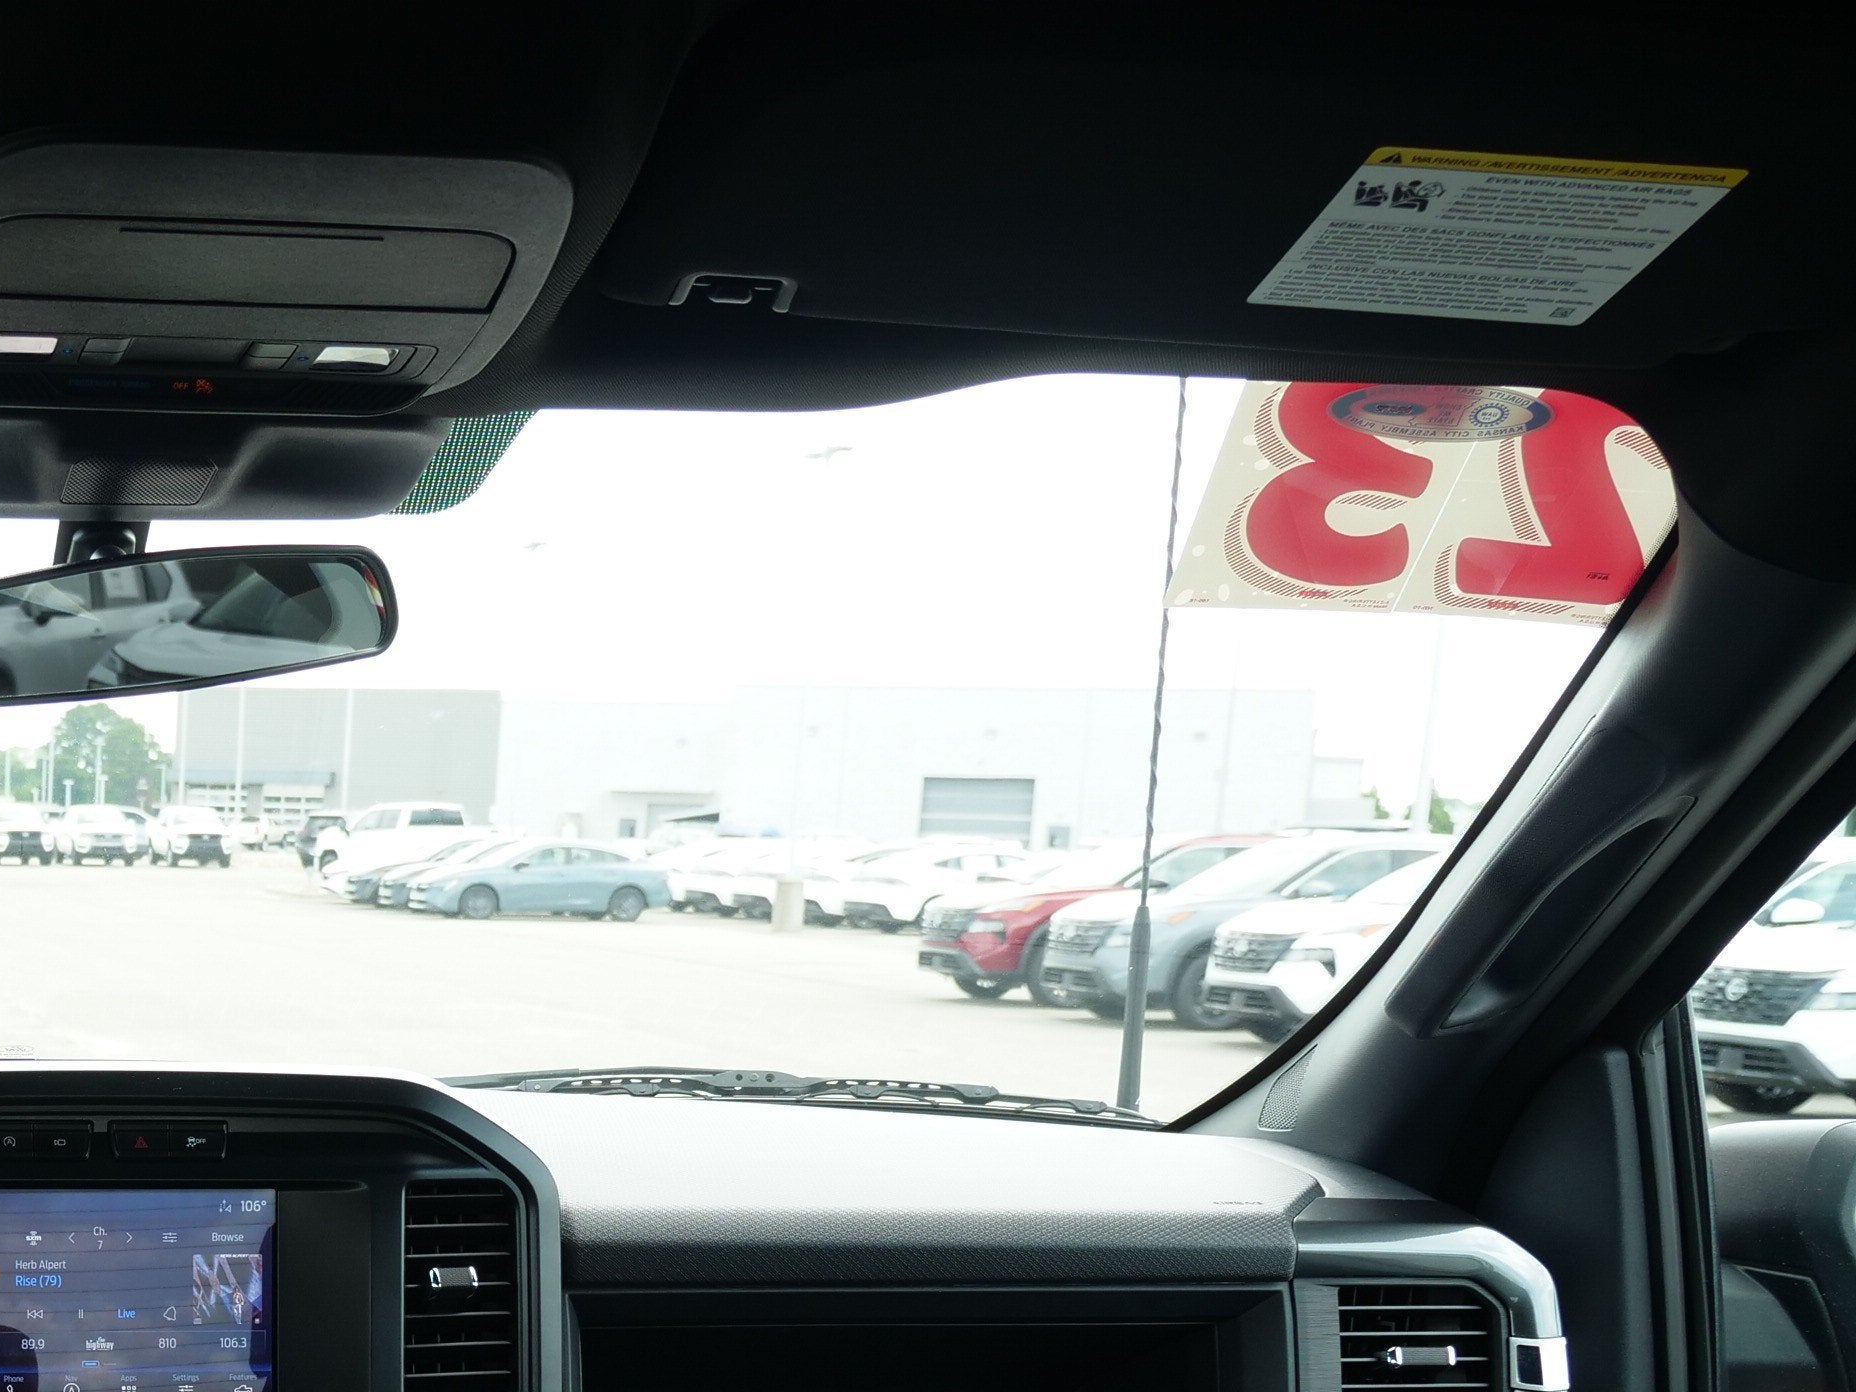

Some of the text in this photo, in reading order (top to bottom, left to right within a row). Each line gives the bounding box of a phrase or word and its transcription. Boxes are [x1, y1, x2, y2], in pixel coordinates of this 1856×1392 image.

[1411, 155, 1480, 167] WARNING
[171, 382, 189, 390] OFF
[240, 1200, 267, 1212] 106°
[93, 1226, 107, 1236] Ch.
[211, 1232, 245, 1242] Browse
[97, 1240, 103, 1250] 7
[15, 1260, 67, 1272] Herb Alpert
[15, 1274, 62, 1288] Rise (79)
[117, 1308, 136, 1319] Live
[21, 1338, 45, 1350] 89.9
[158, 1337, 177, 1349] 810
[219, 1337, 247, 1349] 106.3
[120, 1375, 138, 1383] Apps
[172, 1374, 200, 1383] Settings
[229, 1373, 258, 1381] Features
